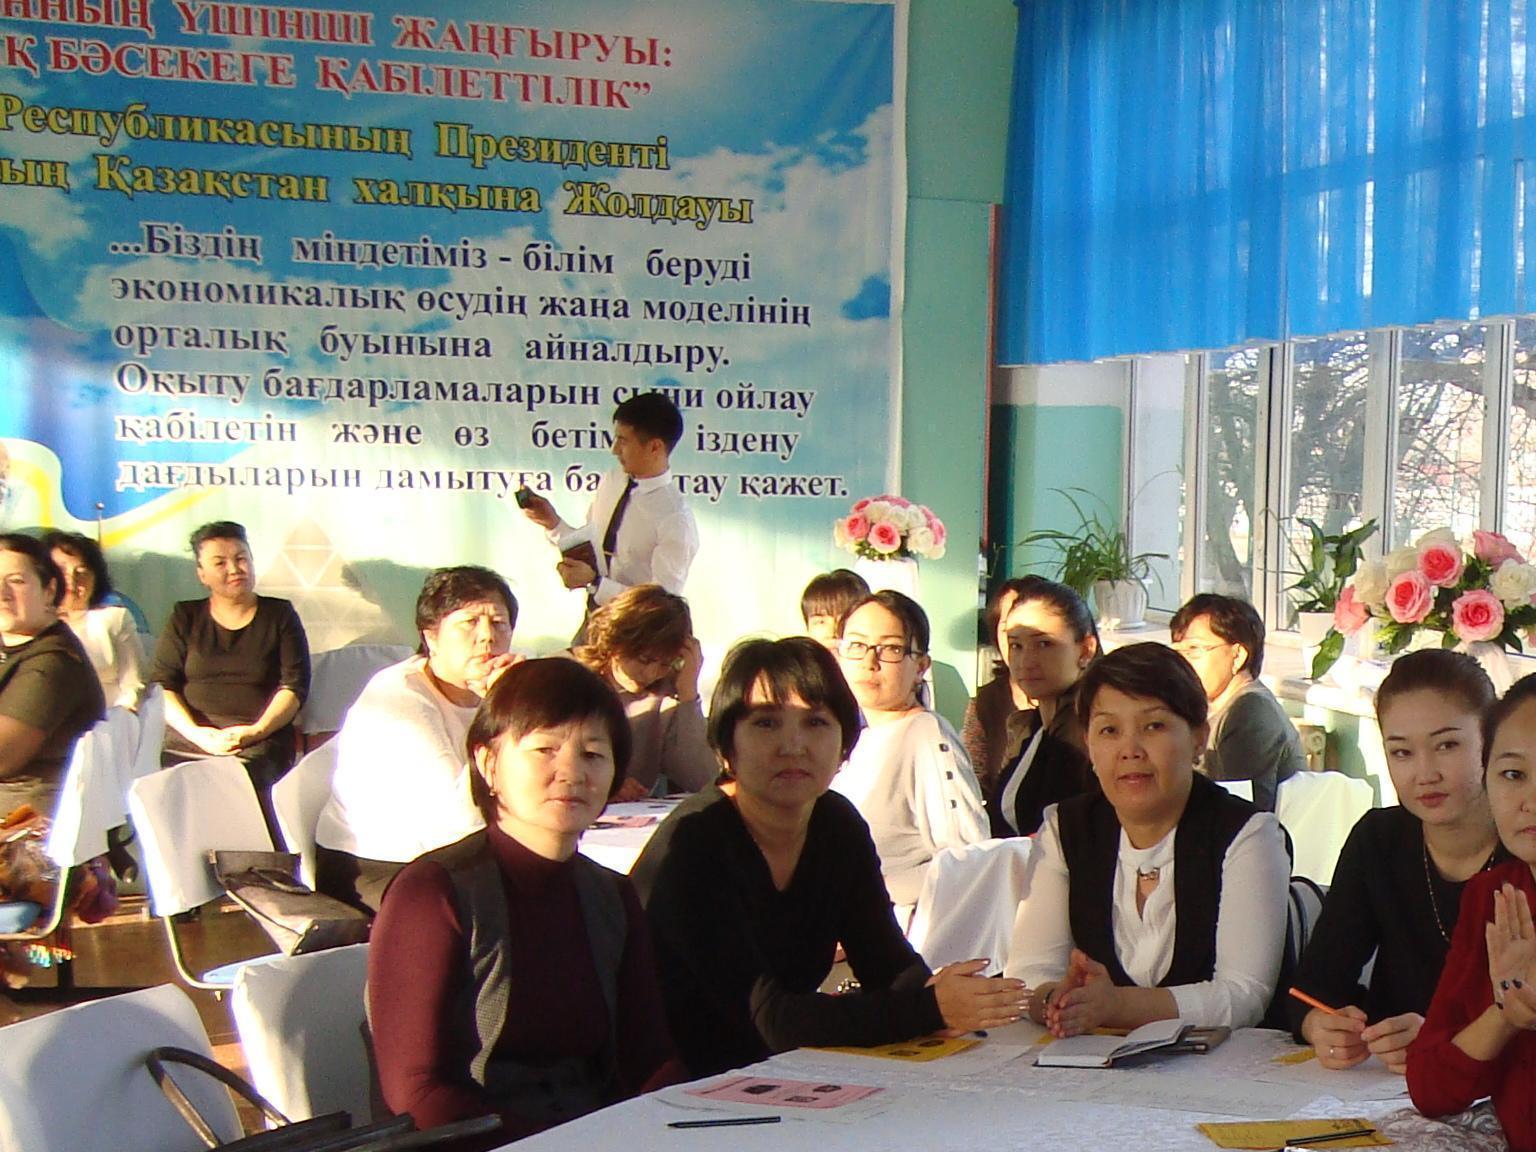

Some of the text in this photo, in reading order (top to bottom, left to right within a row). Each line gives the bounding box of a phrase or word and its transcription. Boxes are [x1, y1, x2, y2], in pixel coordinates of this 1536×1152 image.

[175, 1, 373, 45] ҮШІНШІ
[394, 17, 673, 67] ЖАҢҒЫРУЫ:
[50, 38, 294, 87] БӘСЕКЕГЕ
[318, 57, 651, 109] ҚАБІЛЕТТІЛІК”
[0, 93, 671, 170] Республикасының Президенті
[95, 154, 328, 201] Қазақстан
[353, 177, 542, 213] халқына
[563, 181, 753, 229] Жолдауы
[111, 224, 261, 261] ...Біздің
[294, 233, 487, 268] міндетіміз
[523, 244, 614, 274] білім
[646, 249, 751, 284] беруді
[111, 277, 810, 326] экономикалық өсудің жаңа моделінің
[115, 324, 731, 372] орталық буынына айналдыру.
[117, 363, 250, 403] Оқыту
[263, 370, 599, 412] бағдарламаларын
[716, 382, 814, 416] ойлау
[117, 413, 798, 459] қабілетін және өз бетім іздену
[117, 461, 361, 494] дағдыларын
[376, 468, 552, 498] дамытуға
[740, 474, 848, 497] қажет.
